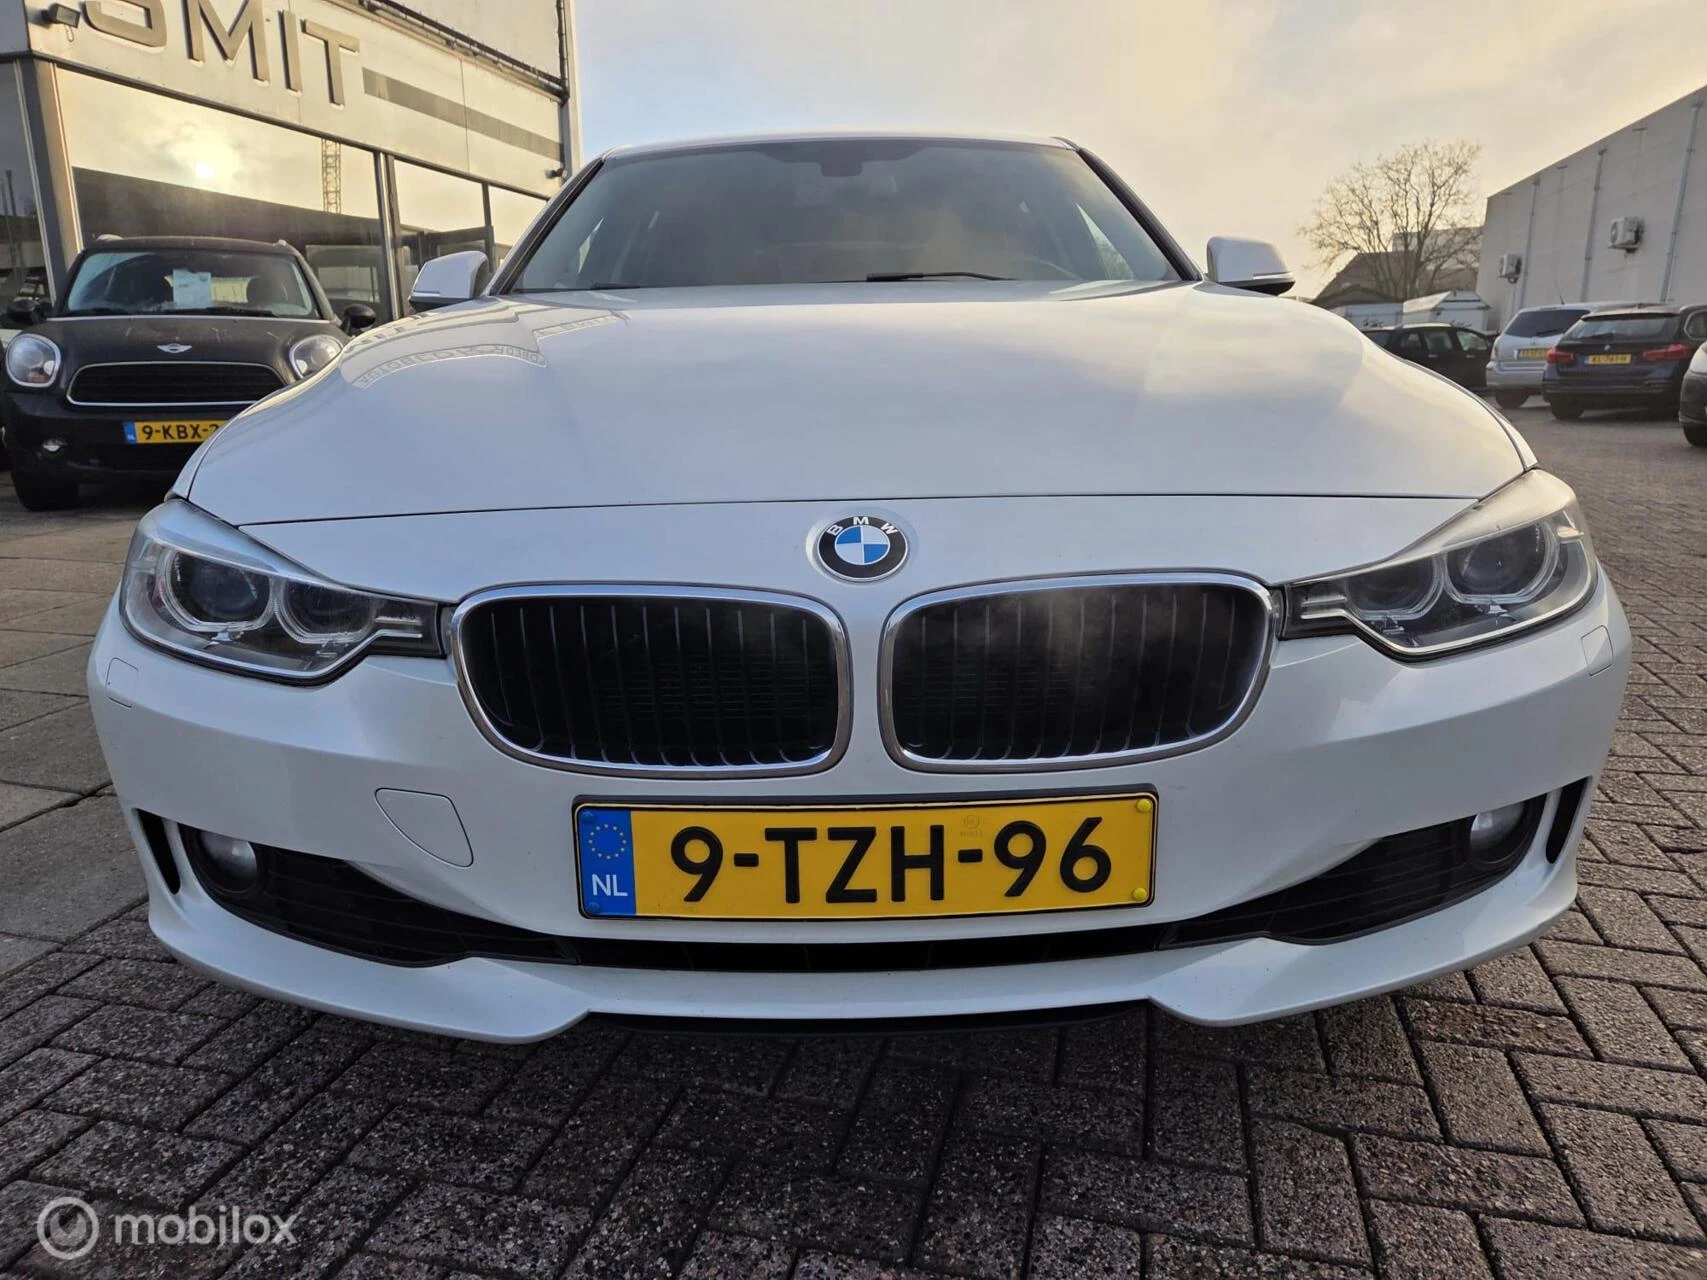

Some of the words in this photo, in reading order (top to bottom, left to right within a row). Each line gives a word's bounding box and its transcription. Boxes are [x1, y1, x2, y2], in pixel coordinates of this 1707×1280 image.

[826, 516, 899, 536] BMW
[670, 816, 1112, 904] 9-TZH-96
[592, 873, 628, 898] NL
